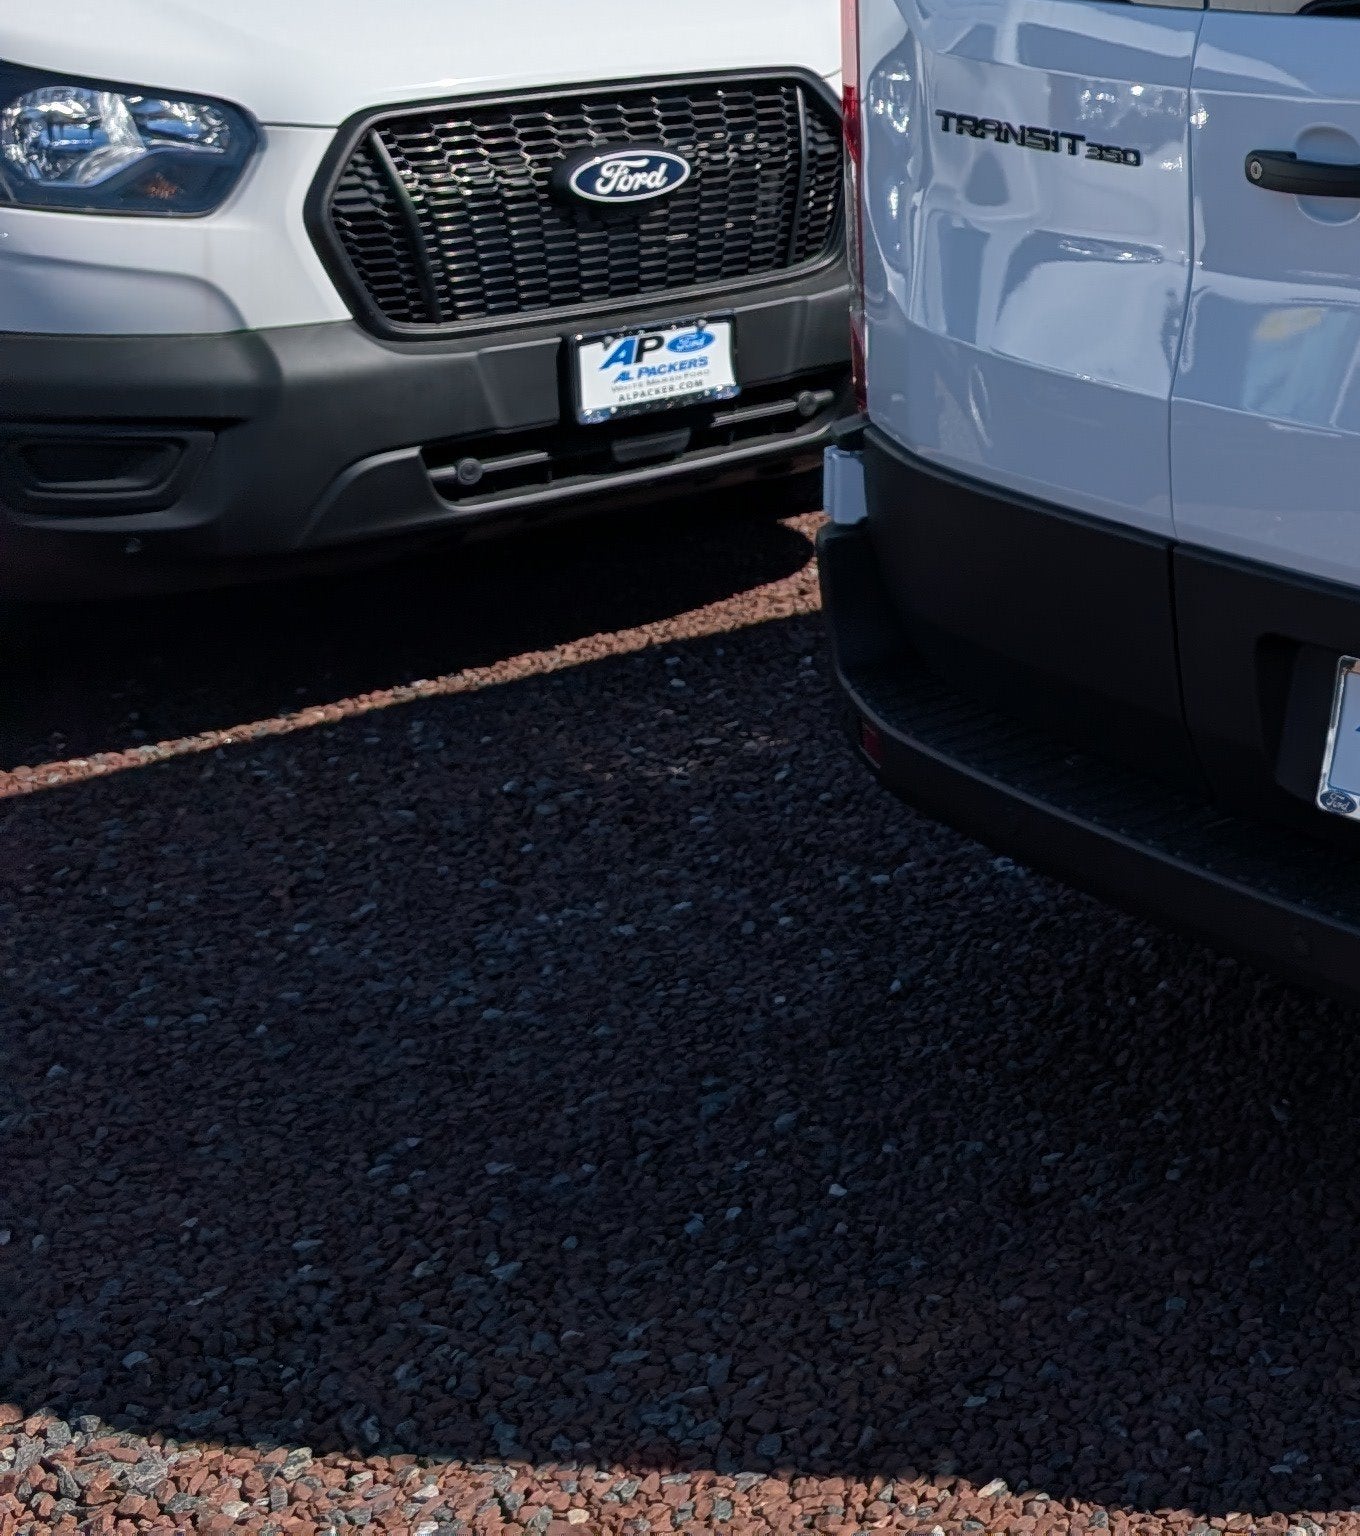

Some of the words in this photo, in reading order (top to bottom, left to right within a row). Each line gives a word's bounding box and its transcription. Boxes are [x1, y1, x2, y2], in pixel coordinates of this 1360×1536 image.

[935, 109, 1086, 156] TRANSIT
[1085, 141, 1142, 166] 350
[595, 158, 668, 195] Ford
[600, 335, 665, 370] AP
[613, 370, 635, 384] AL
[618, 380, 703, 402] ALPACKER.COM
